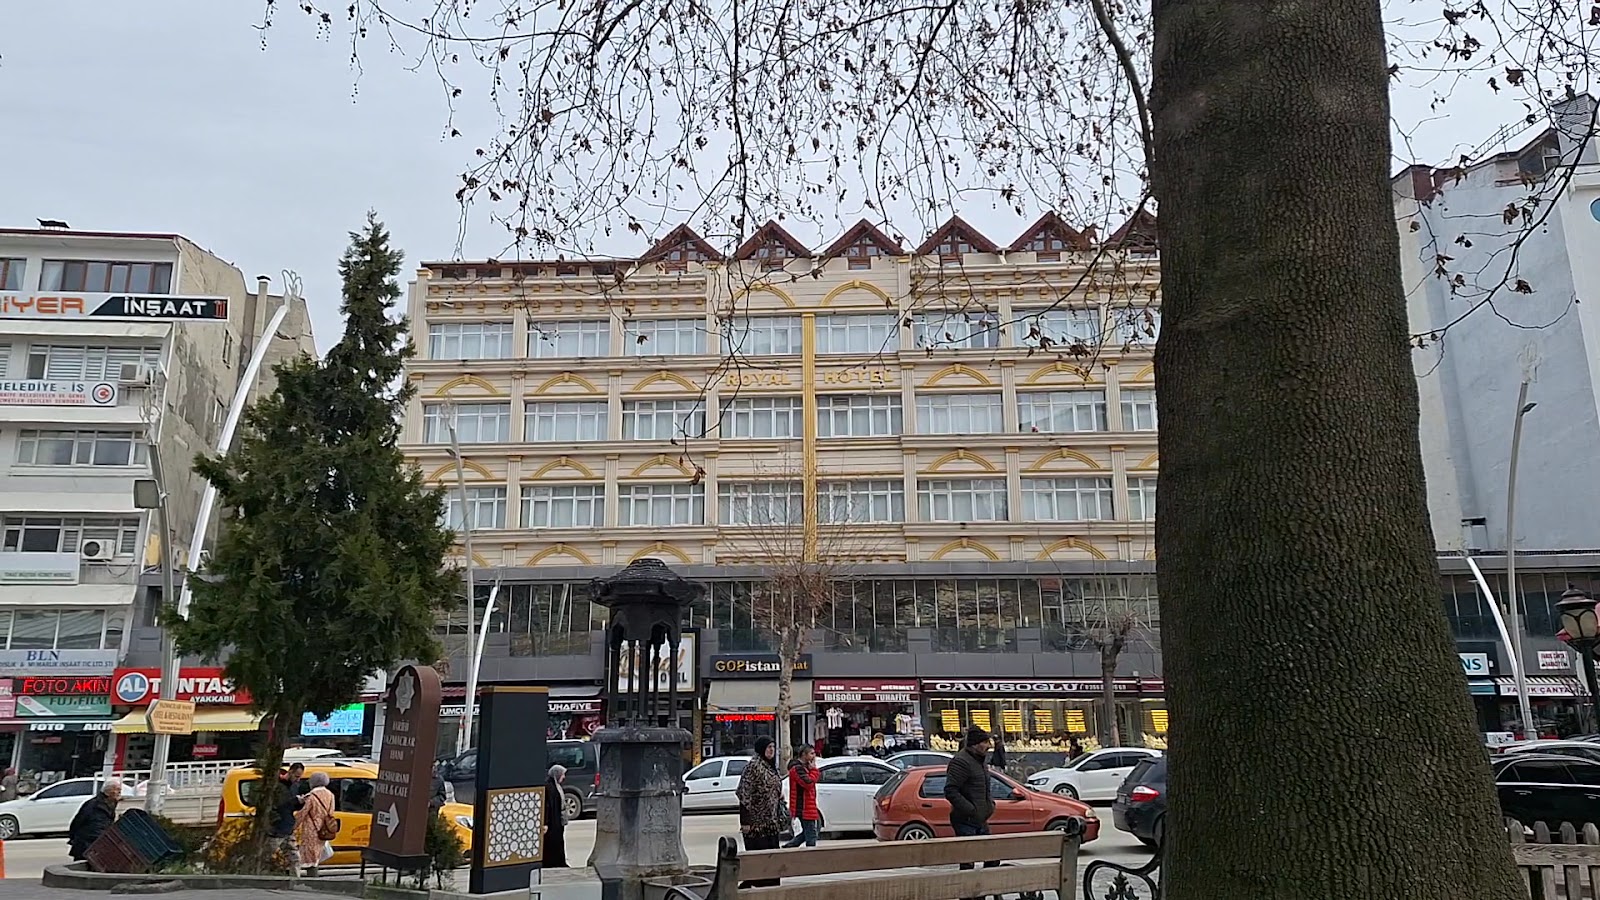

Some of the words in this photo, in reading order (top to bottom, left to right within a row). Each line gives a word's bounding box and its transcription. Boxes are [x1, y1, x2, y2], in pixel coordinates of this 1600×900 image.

[124, 296, 207, 316] İNŞAAT
[726, 371, 792, 386] ROYAL
[824, 370, 894, 384] HOTEL
[27, 650, 61, 661] BLN
[23, 679, 68, 693] FOTO
[71, 679, 109, 693] AKIN
[30, 723, 65, 731] FOTO
